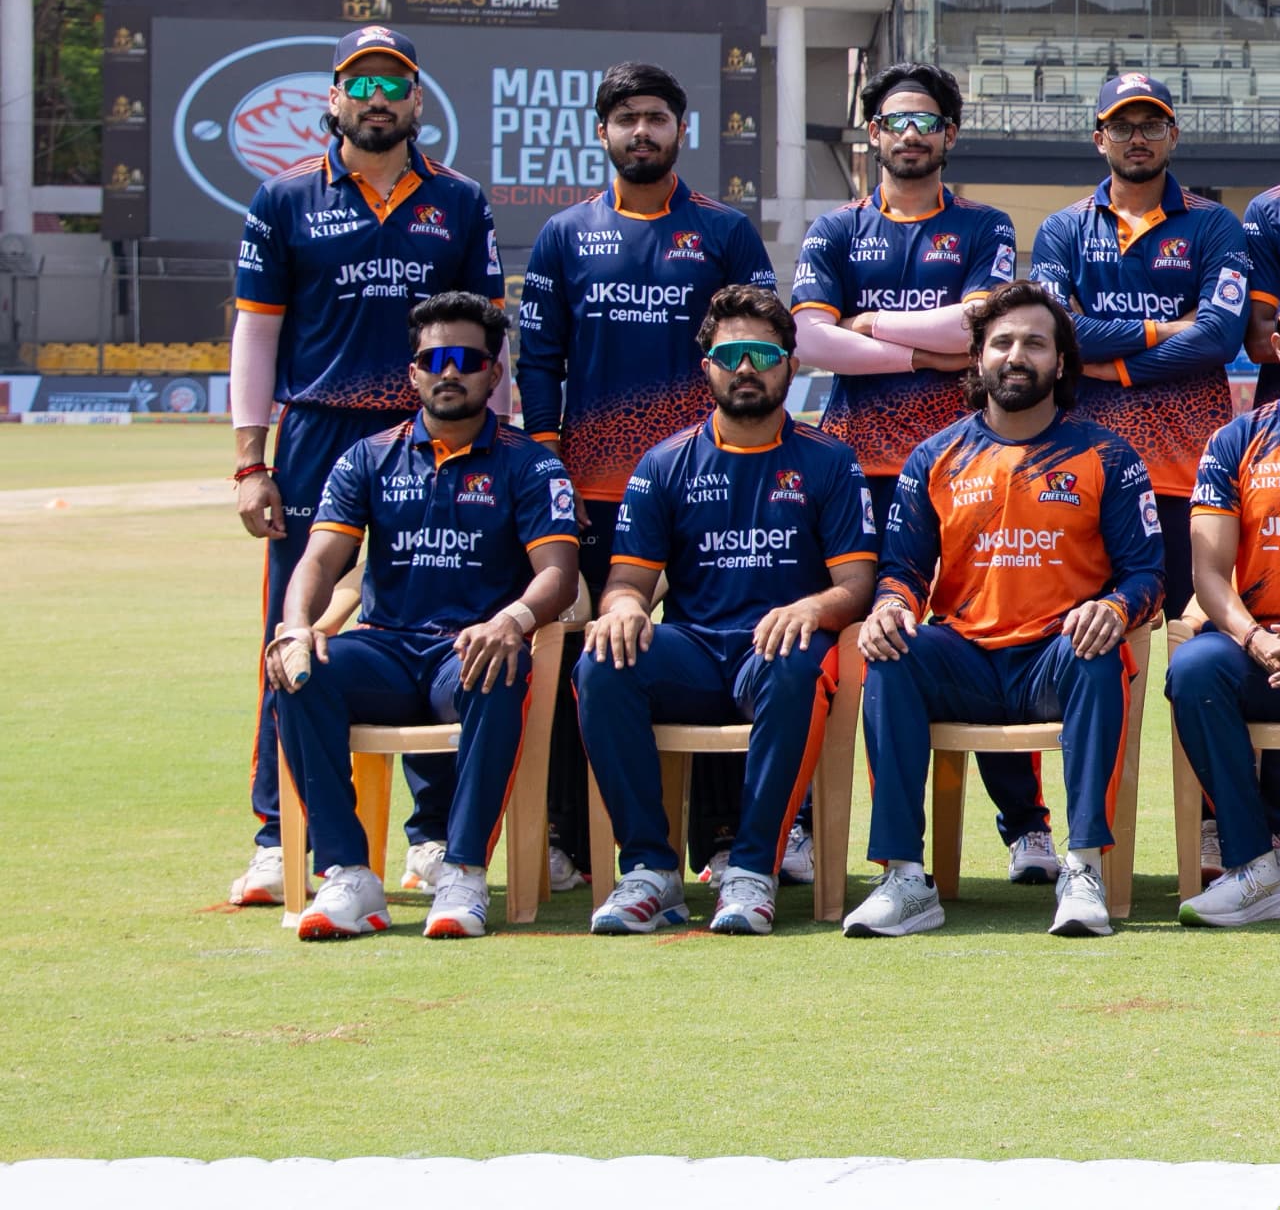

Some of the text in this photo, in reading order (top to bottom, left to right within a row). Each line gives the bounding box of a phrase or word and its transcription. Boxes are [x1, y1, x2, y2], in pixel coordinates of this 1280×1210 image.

[492, 68, 603, 107] MAD
[492, 147, 614, 186] LEAG
[305, 207, 358, 224] VISWA
[310, 222, 358, 239] KIRTI
[577, 230, 623, 242] VISWA
[579, 243, 620, 256] KIRTI
[1154, 257, 1191, 269] CHEETAHS
[335, 258, 433, 285] JKsuper
[586, 283, 693, 313] JKsuper
[1091, 291, 1183, 316] JKsuper
[610, 308, 668, 323] cement
[950, 476, 994, 490] VISWA
[383, 489, 424, 502] KIRTI
[687, 489, 728, 504] KIRTI
[953, 489, 993, 508] KIRTI
[1040, 492, 1079, 505] CHEETAHS
[699, 528, 796, 554] JKsuper
[717, 552, 773, 568] cement
